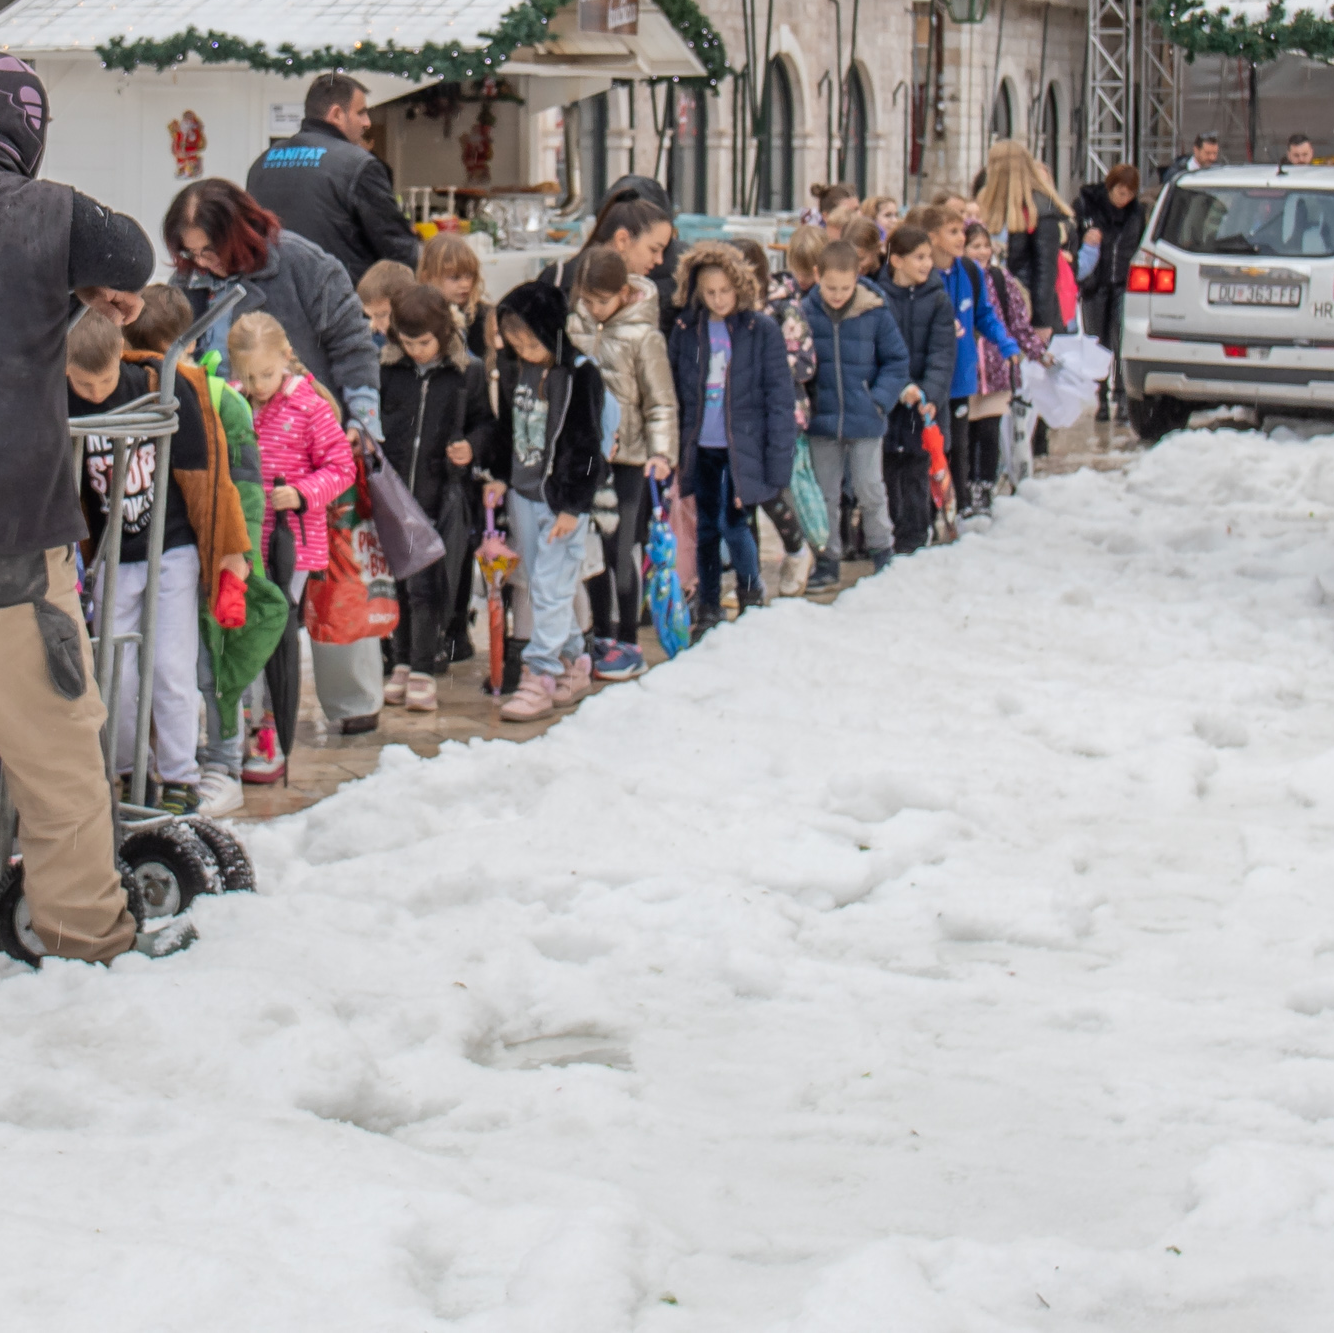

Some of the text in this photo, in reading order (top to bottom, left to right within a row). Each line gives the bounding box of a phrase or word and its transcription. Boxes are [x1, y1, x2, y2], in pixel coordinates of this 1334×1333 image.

[267, 146, 327, 161] SANITAT
[1219, 285, 1235, 300] DU
[1313, 302, 1334, 318] HR
